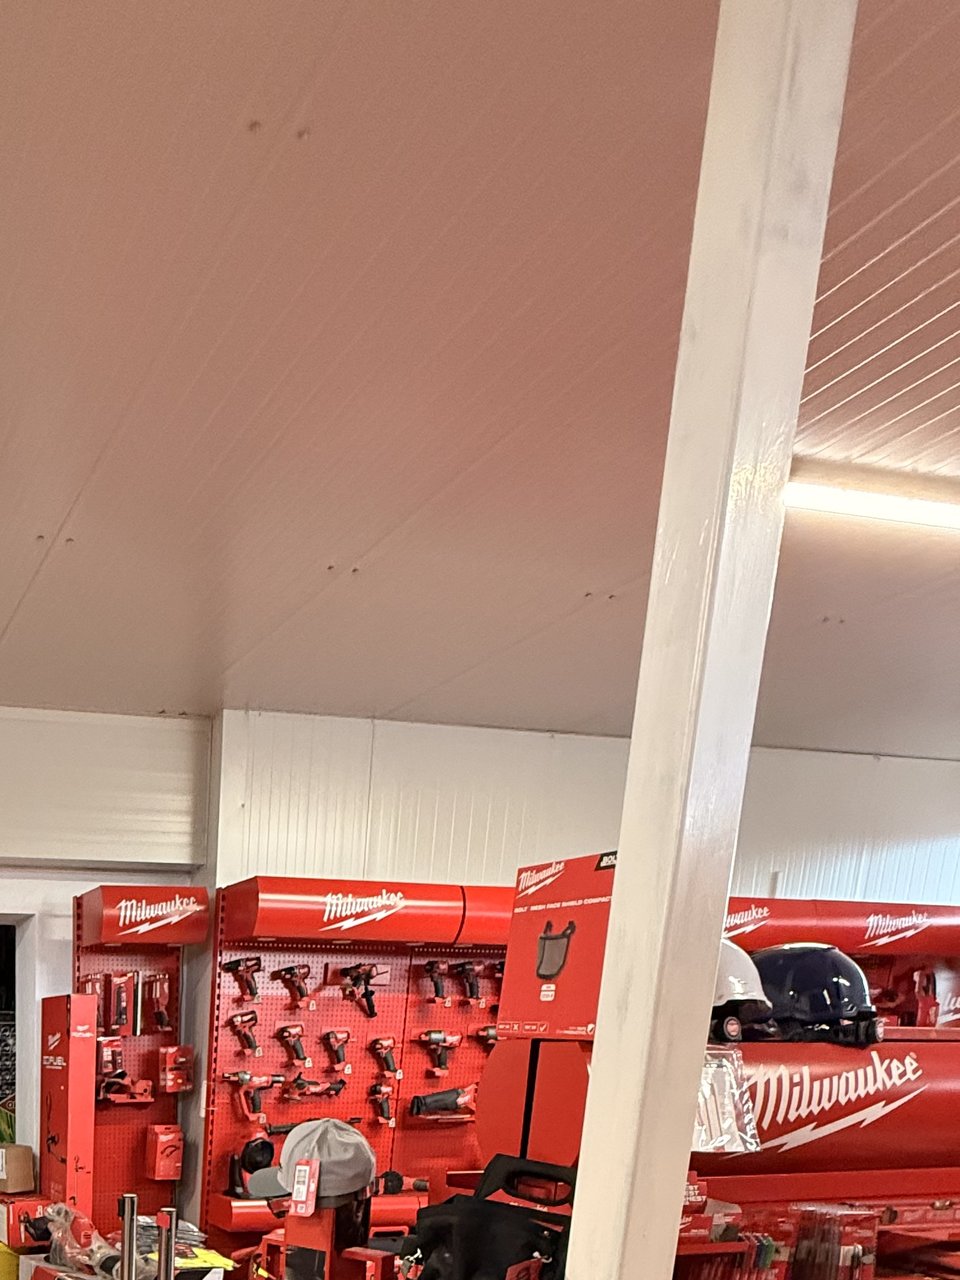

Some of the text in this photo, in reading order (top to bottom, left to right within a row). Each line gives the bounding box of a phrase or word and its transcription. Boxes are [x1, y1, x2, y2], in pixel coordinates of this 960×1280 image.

[518, 862, 566, 891] Milwaukee
[116, 894, 197, 926] Milwaukee
[322, 888, 404, 923] Milwaukee
[723, 904, 770, 929] waukee
[864, 909, 928, 940] Milwaukee
[748, 1050, 923, 1130] Milwaukee
